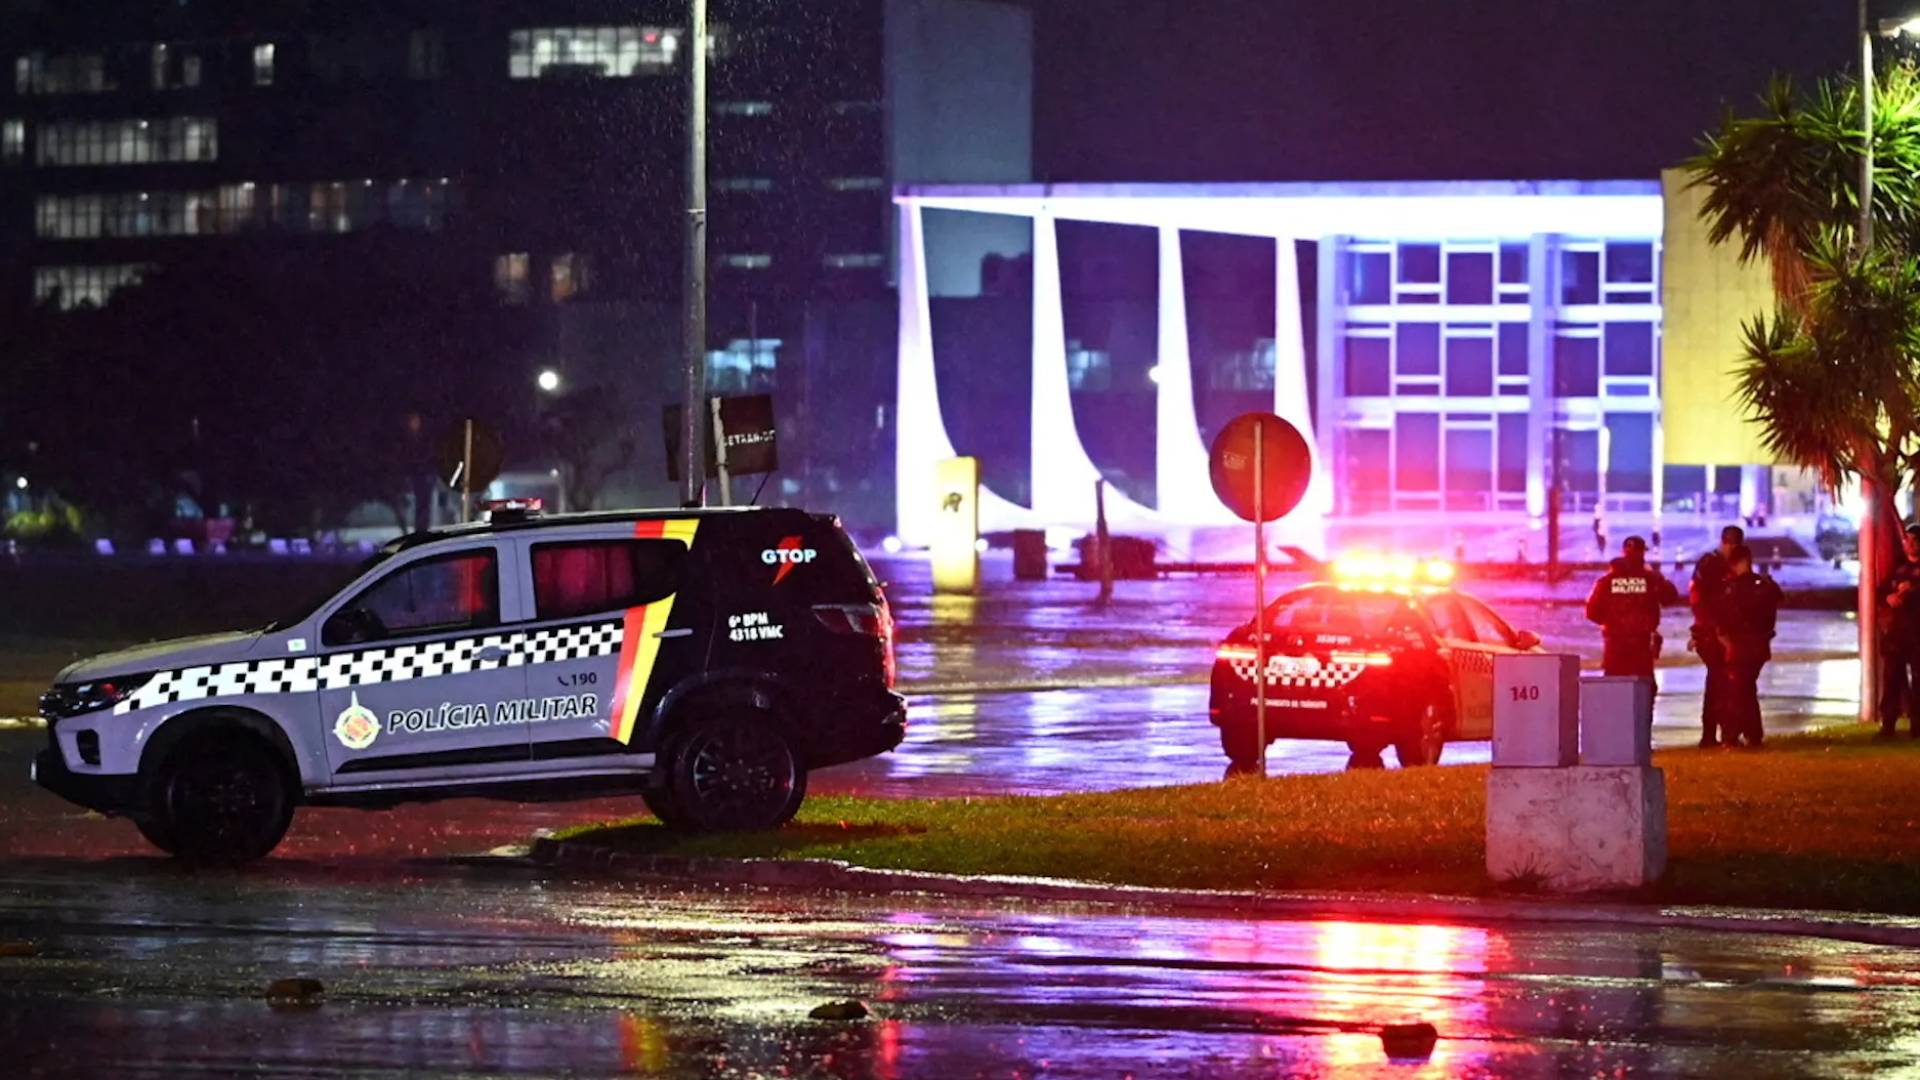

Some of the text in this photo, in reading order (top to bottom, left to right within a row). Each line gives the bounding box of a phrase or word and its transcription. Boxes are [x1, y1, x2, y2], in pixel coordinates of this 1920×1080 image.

[723, 429, 776, 447] ETRAN-DF
[761, 548, 817, 565] GTOP
[1611, 584, 1647, 594] MILITAR
[742, 611, 769, 627] BPM
[729, 627, 758, 642] 4318
[569, 672, 597, 687] 190
[1510, 685, 1540, 702] 140
[386, 693, 597, 735] POLÍCIA MILITAR
